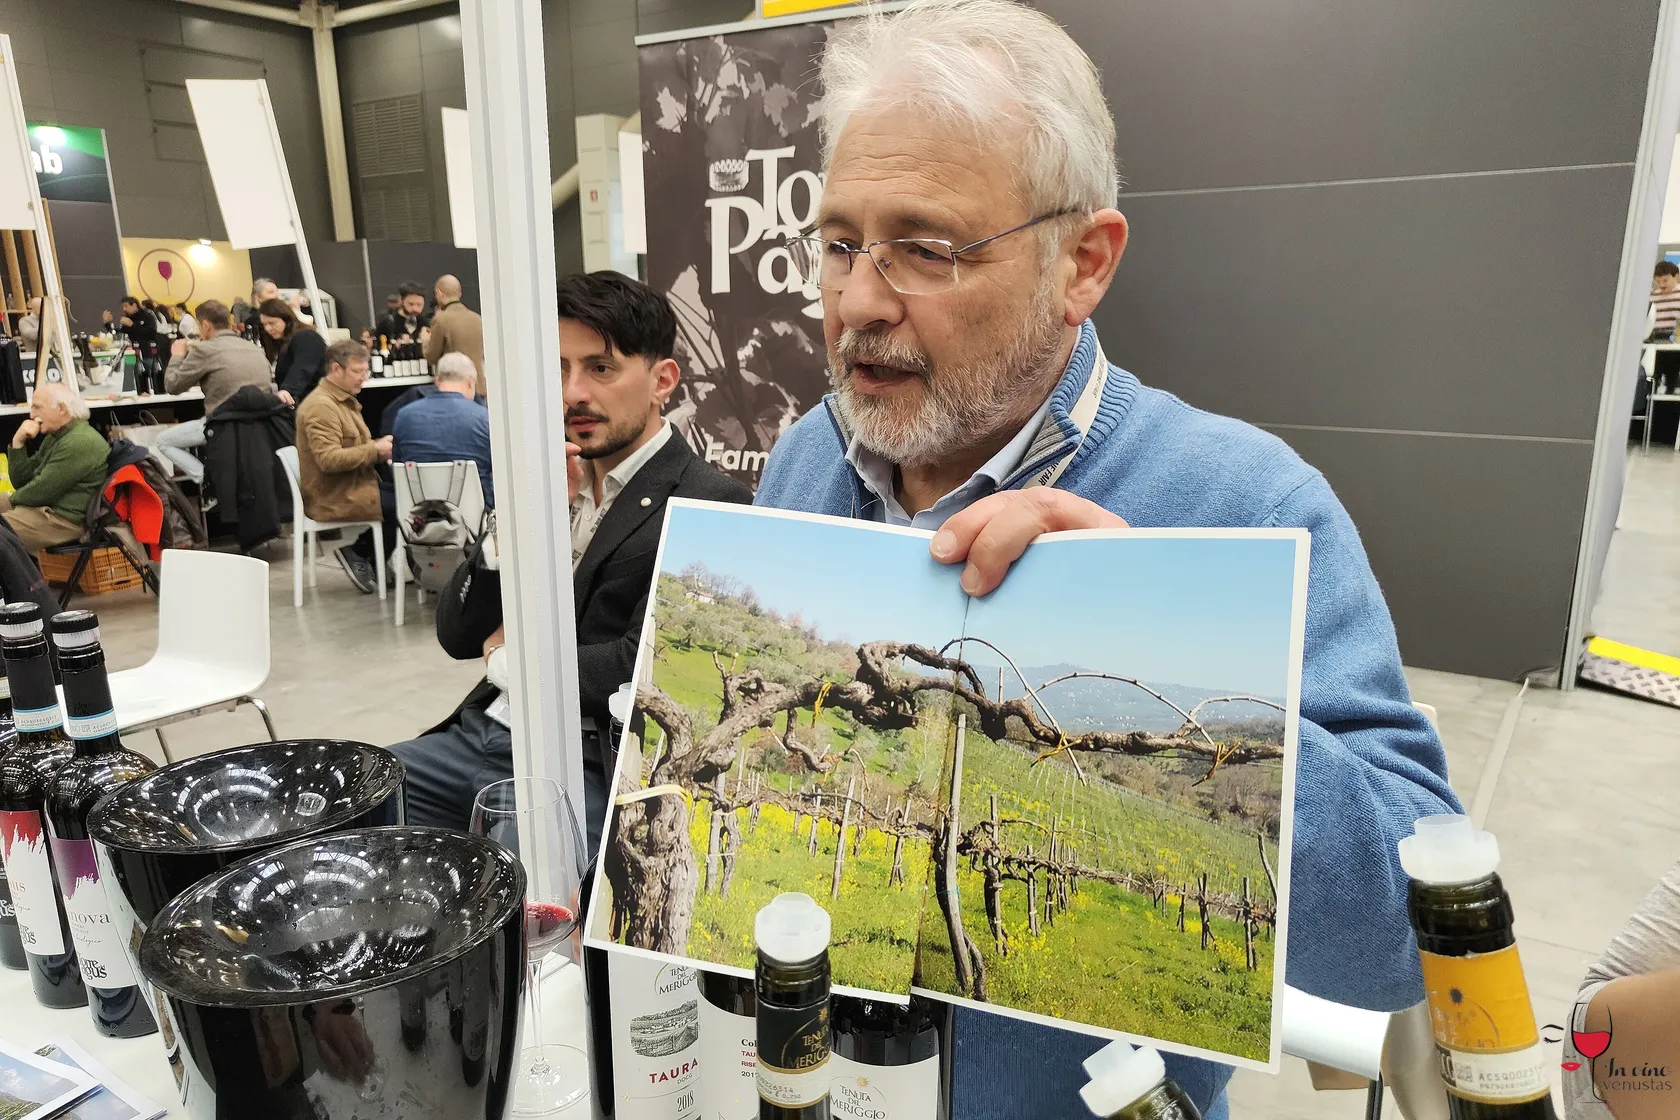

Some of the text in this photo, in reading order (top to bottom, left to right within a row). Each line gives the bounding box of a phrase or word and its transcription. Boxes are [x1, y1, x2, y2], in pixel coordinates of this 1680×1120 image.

[1038, 467, 1055, 487] FAIR
[649, 1057, 699, 1084] TAURA
[677, 1073, 693, 1085] DOCG
[677, 1090, 695, 1112] 2018
[840, 1084, 872, 1102] TENUTA
[848, 1097, 861, 1106] DEL
[830, 1096, 886, 1120] MERIGGIO
